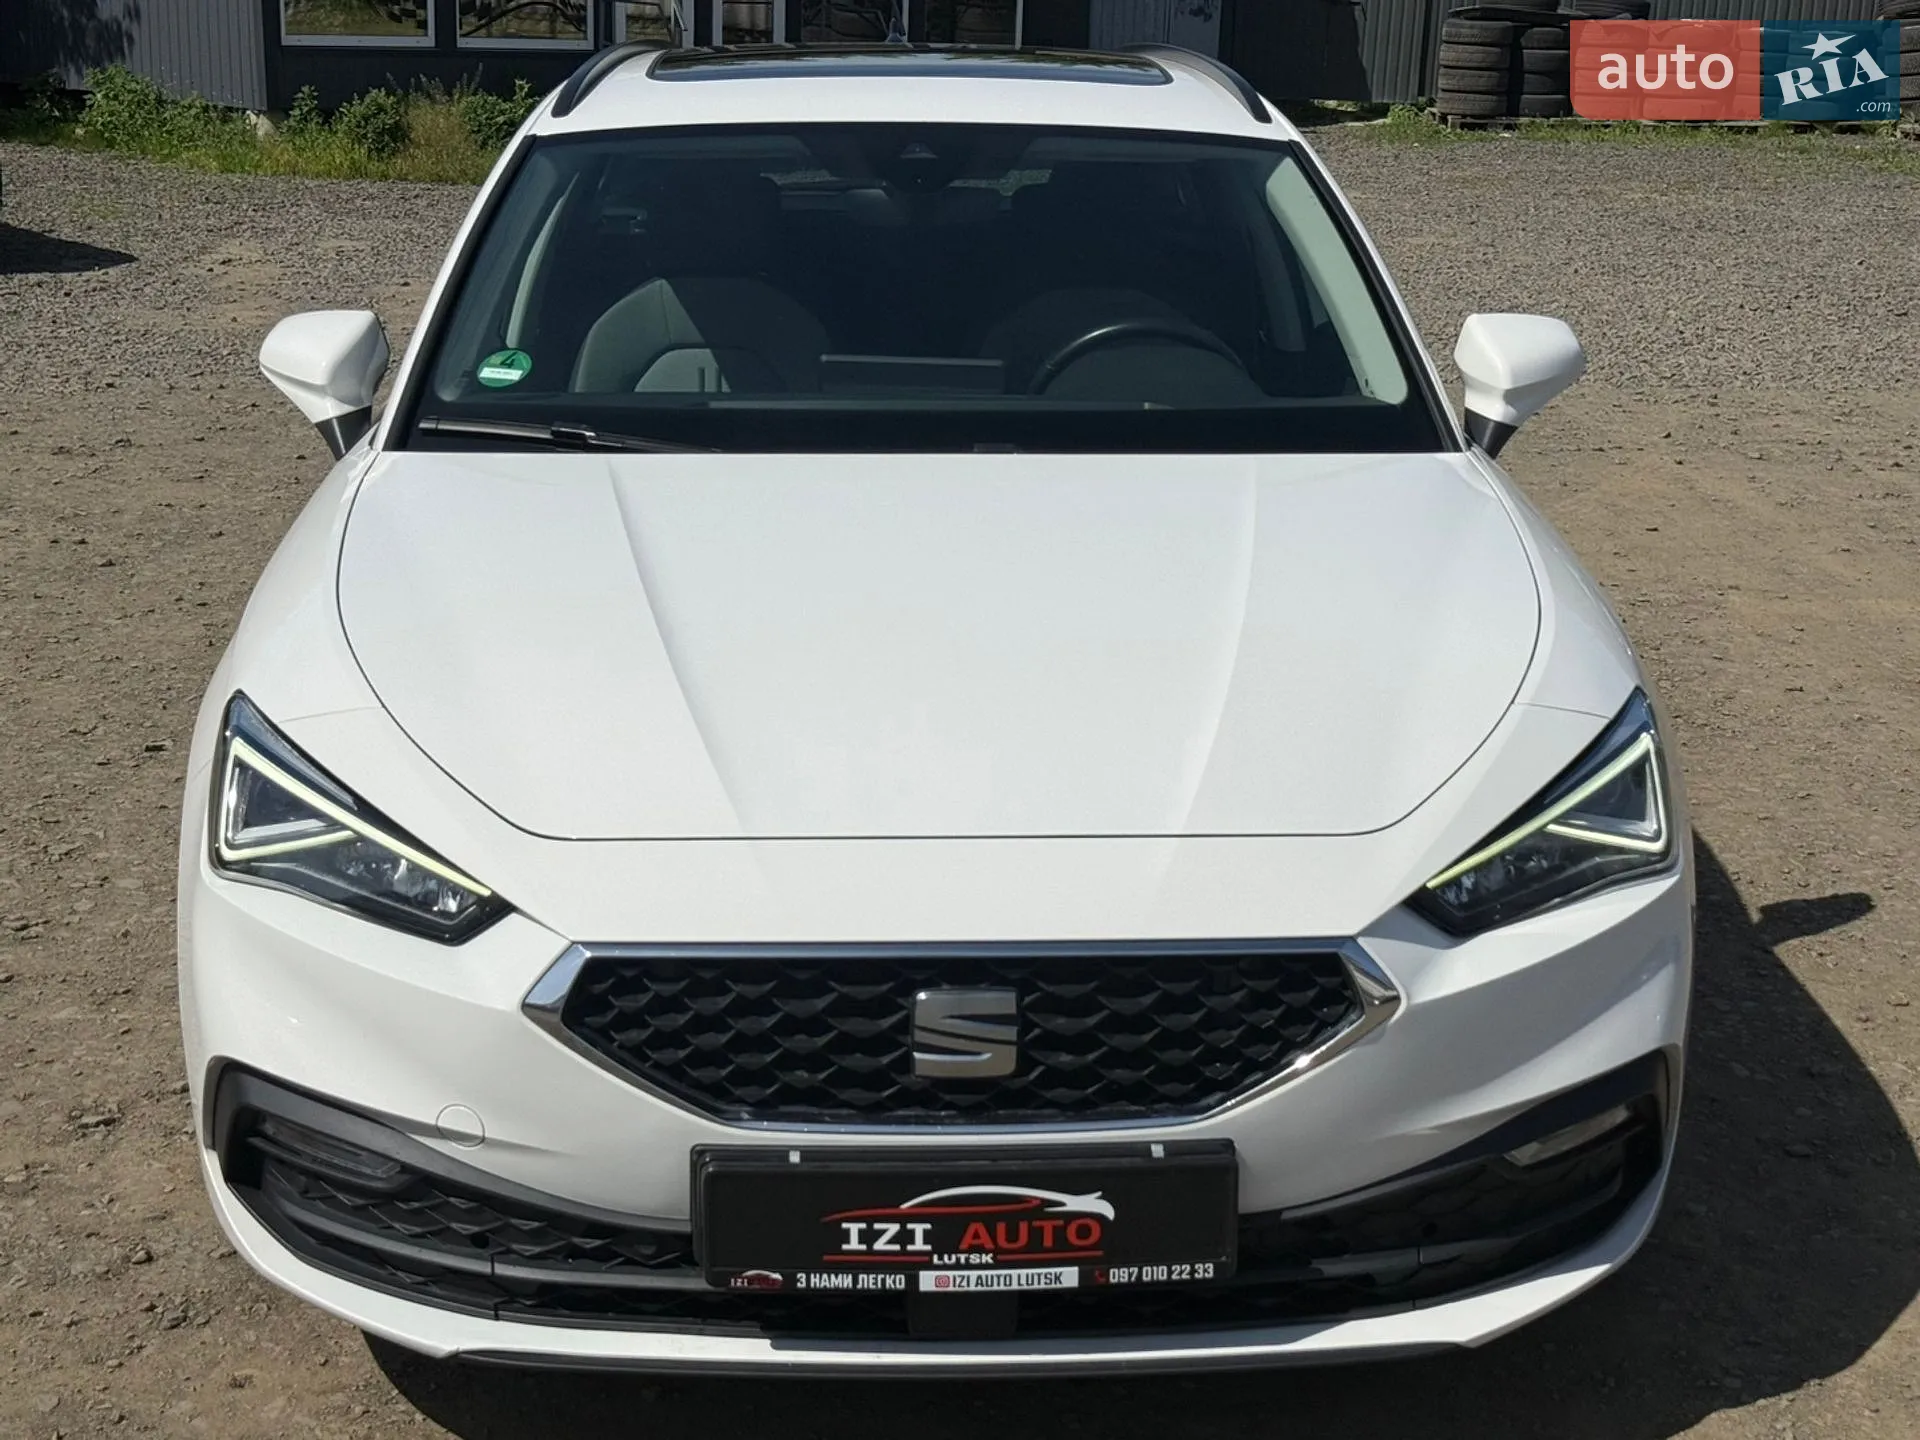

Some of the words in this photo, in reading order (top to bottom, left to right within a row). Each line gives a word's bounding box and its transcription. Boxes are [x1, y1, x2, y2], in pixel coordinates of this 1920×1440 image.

[841, 1222, 932, 1251] IZI
[958, 1218, 1101, 1250] AUTO
[932, 1253, 994, 1265] LUTSK
[952, 1274, 971, 1288] IZI
[974, 1273, 1013, 1288] AUTO
[1017, 1271, 1063, 1286] LUTSK
[1109, 1267, 1139, 1283] 097
[1142, 1265, 1167, 1281] 010
[1171, 1264, 1191, 1280] 22
[1194, 1262, 1214, 1279] 33
[810, 1273, 852, 1289] НАМИ
[856, 1273, 906, 1290] ЛЕГКО
